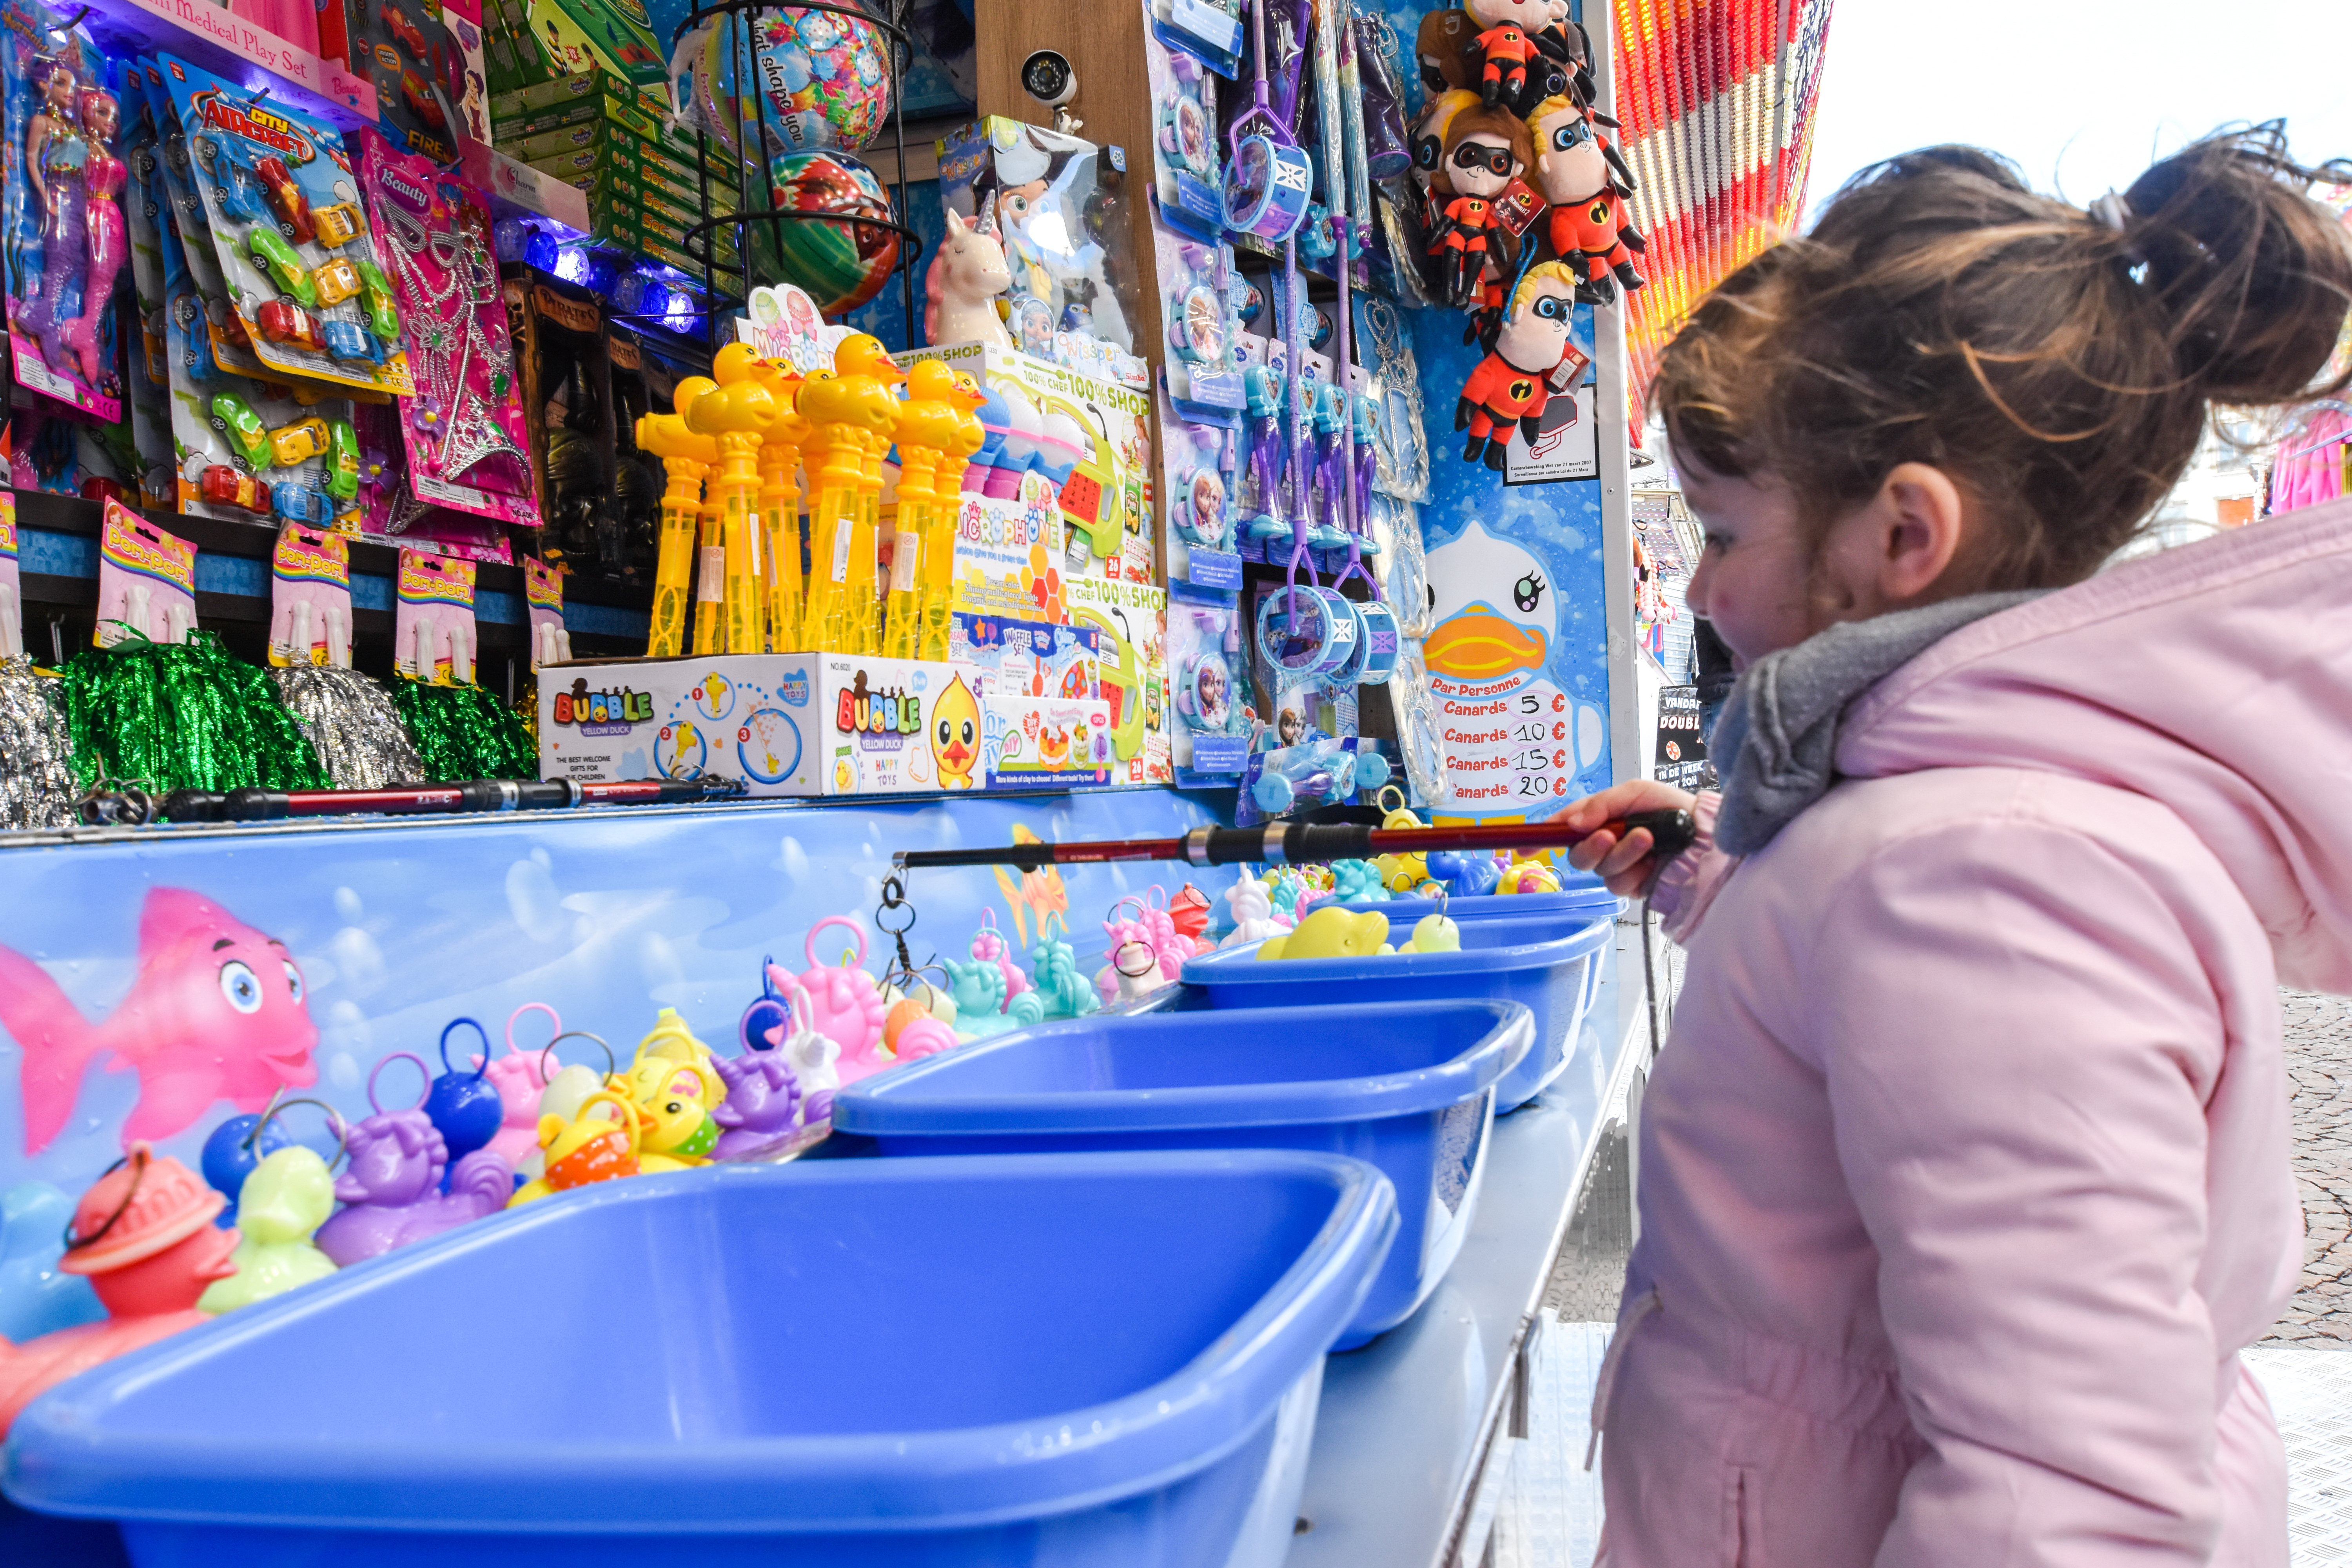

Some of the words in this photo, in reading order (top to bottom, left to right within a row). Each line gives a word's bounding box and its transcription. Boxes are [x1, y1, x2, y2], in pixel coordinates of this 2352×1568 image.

[176, 0, 239, 45] Medical
[242, 29, 277, 66] Play
[282, 51, 307, 78] Set
[358, 42, 368, 51] STOP
[377, 49, 395, 59] URGENT
[381, 57, 397, 66] ACTION
[568, 48, 577, 59] VS
[332, 77, 363, 98] Beauty
[753, 20, 768, 53] hat
[762, 56, 793, 109] shape
[780, 115, 804, 143] you
[251, 108, 289, 134] CITY
[407, 129, 444, 155] FIRE
[381, 169, 428, 207] Beauty
[507, 167, 536, 193] Charm
[1508, 195, 1527, 214] INCREDIBLES
[540, 289, 597, 328] PIRATES
[611, 342, 639, 367] RATES
[944, 345, 982, 361] SHOP
[1058, 334, 1120, 366] Wissper
[1125, 372, 1145, 382] Simba
[1024, 370, 1046, 387] 100%
[1048, 378, 1068, 393] CHEF
[1068, 373, 1107, 406] 100%
[1107, 387, 1151, 417] SHOP
[960, 503, 1059, 549] ICROPHONE
[1109, 559, 1119, 572] 26
[965, 583, 987, 595] Shining
[985, 576, 1005, 587] Dream
[961, 593, 986, 604] Dynamic
[998, 599, 1025, 610] melodious
[1076, 589, 1095, 601] CHEF
[1095, 581, 1131, 607] 100%
[950, 630, 968, 641] REAM
[1005, 628, 1031, 646] WAFFLE
[1014, 643, 1025, 656] SET
[783, 682, 806, 690] HAPPY
[1432, 678, 1456, 693] Par
[1459, 677, 1521, 697] Personne
[554, 691, 654, 724] BUBBLE
[837, 688, 921, 734] BUBBLE
[1444, 701, 1507, 716] Canards
[1521, 695, 1540, 714] 5
[1552, 693, 1565, 713] €
[583, 726, 608, 736] YELLOW
[610, 726, 629, 735] DUCK
[1445, 728, 1508, 743] Canards
[1514, 723, 1545, 741] 10
[1552, 721, 1565, 740] €
[1660, 716, 1700, 730] DOUBL
[862, 739, 885, 750] YELLOW
[886, 739, 902, 749] DUCK
[1004, 737, 1019, 753] DIY
[875, 759, 898, 771] HAPPY
[1132, 761, 1142, 774] 26
[1446, 756, 1508, 771] Canards
[1512, 749, 1548, 770] 15
[1552, 749, 1566, 768] €
[1659, 771, 1667, 780] IN
[1669, 767, 1679, 778] DE
[1681, 762, 1704, 775] WEEK
[878, 775, 897, 787] TOYS
[1452, 783, 1509, 798] anards
[1518, 776, 1548, 796] 20
[1553, 777, 1566, 796] €
[1682, 775, 1697, 788] 20H
